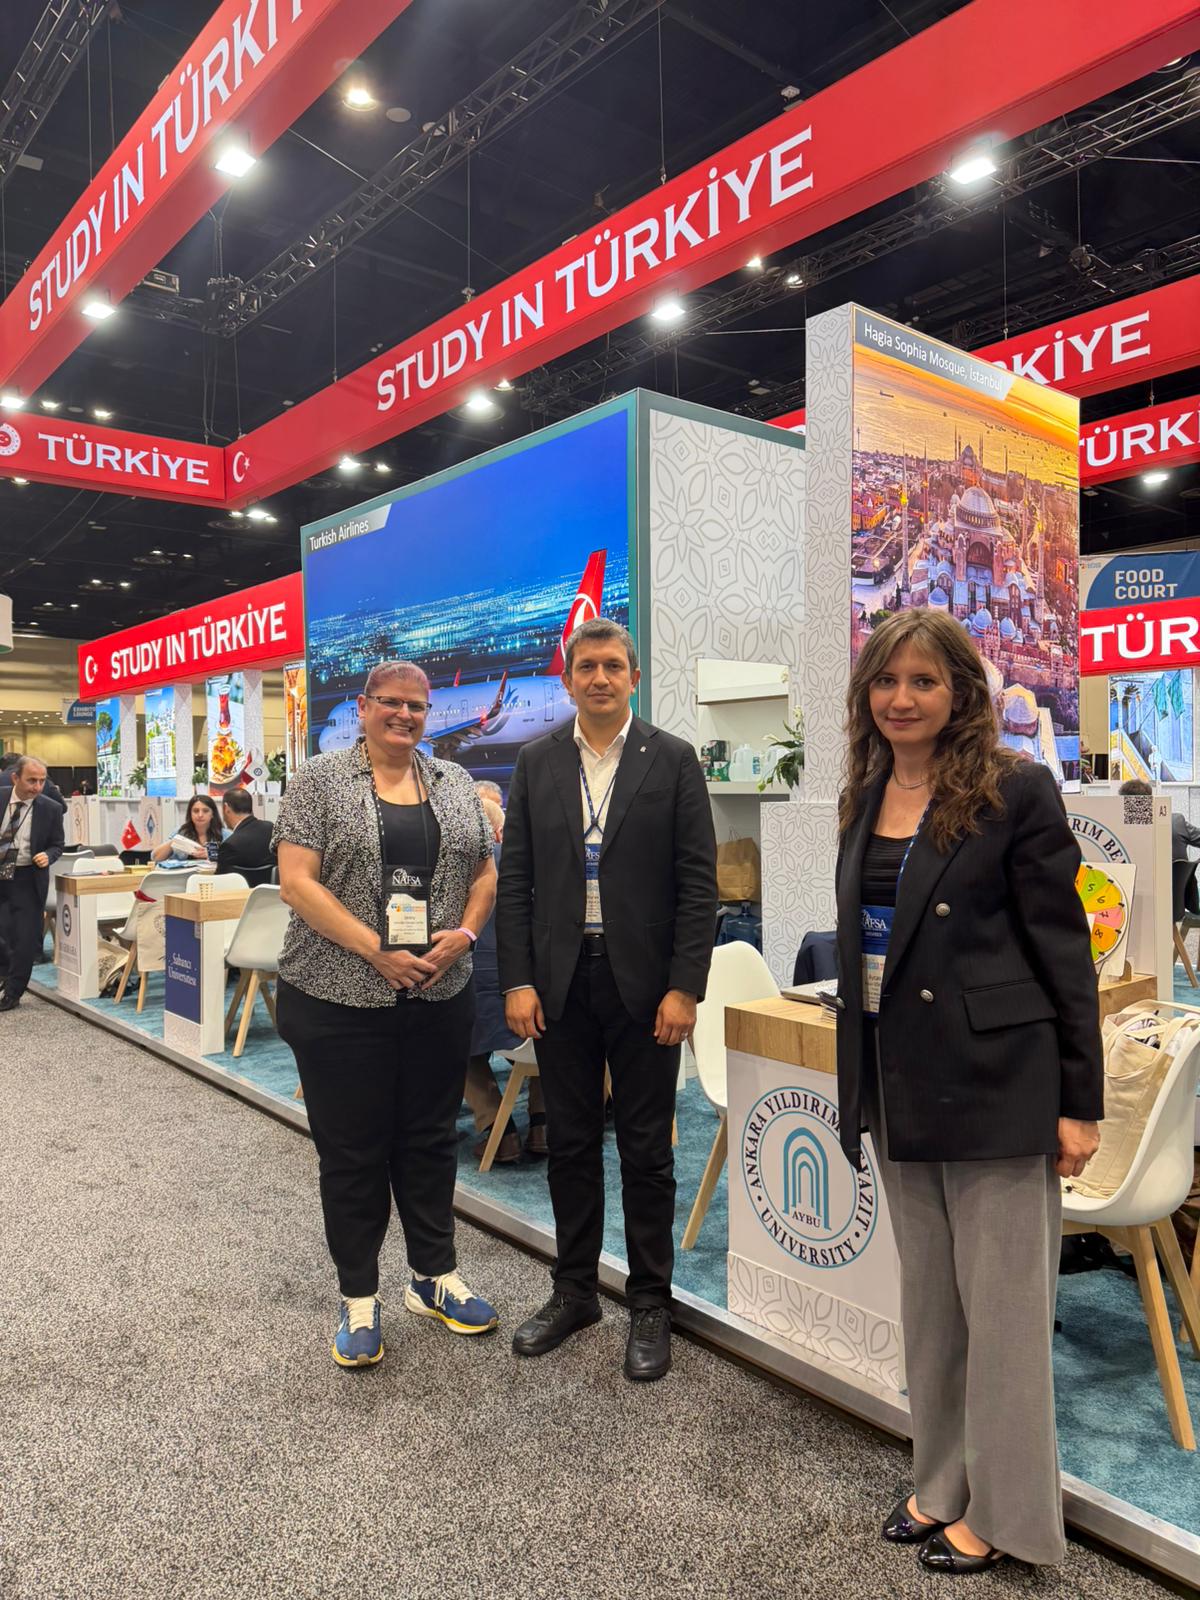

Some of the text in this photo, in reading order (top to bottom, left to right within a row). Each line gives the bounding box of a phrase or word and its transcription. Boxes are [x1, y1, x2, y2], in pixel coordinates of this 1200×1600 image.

[29, 0, 303, 331] STUDY IN TÜRKİ
[376, 124, 814, 411] STUDY IN TÜRKİYE
[863, 321, 893, 348] Hagia
[894, 335, 927, 361] Sophia
[929, 350, 968, 380] Mosque,
[991, 310, 1151, 385] KİYE
[38, 431, 210, 486] TÜRKİYE
[1079, 410, 1200, 468] ÜRK
[309, 519, 369, 551] Turkish Airlines
[1115, 568, 1164, 584] FOOD
[1115, 583, 1178, 600] COURT
[111, 601, 287, 680] STUDY IN TÜRKİYE
[1080, 611, 1200, 663] TÜR
[1159, 805, 1167, 817] A3
[392, 873, 422, 887] NAFSA
[1087, 883, 1096, 892] 5
[1096, 895, 1106, 904] 6
[745, 1112, 768, 1189] ANKARA
[764, 1091, 840, 1133] YILDIRIM
[761, 1207, 857, 1266] UNIVERSITY
[791, 1210, 821, 1228] AYBU
